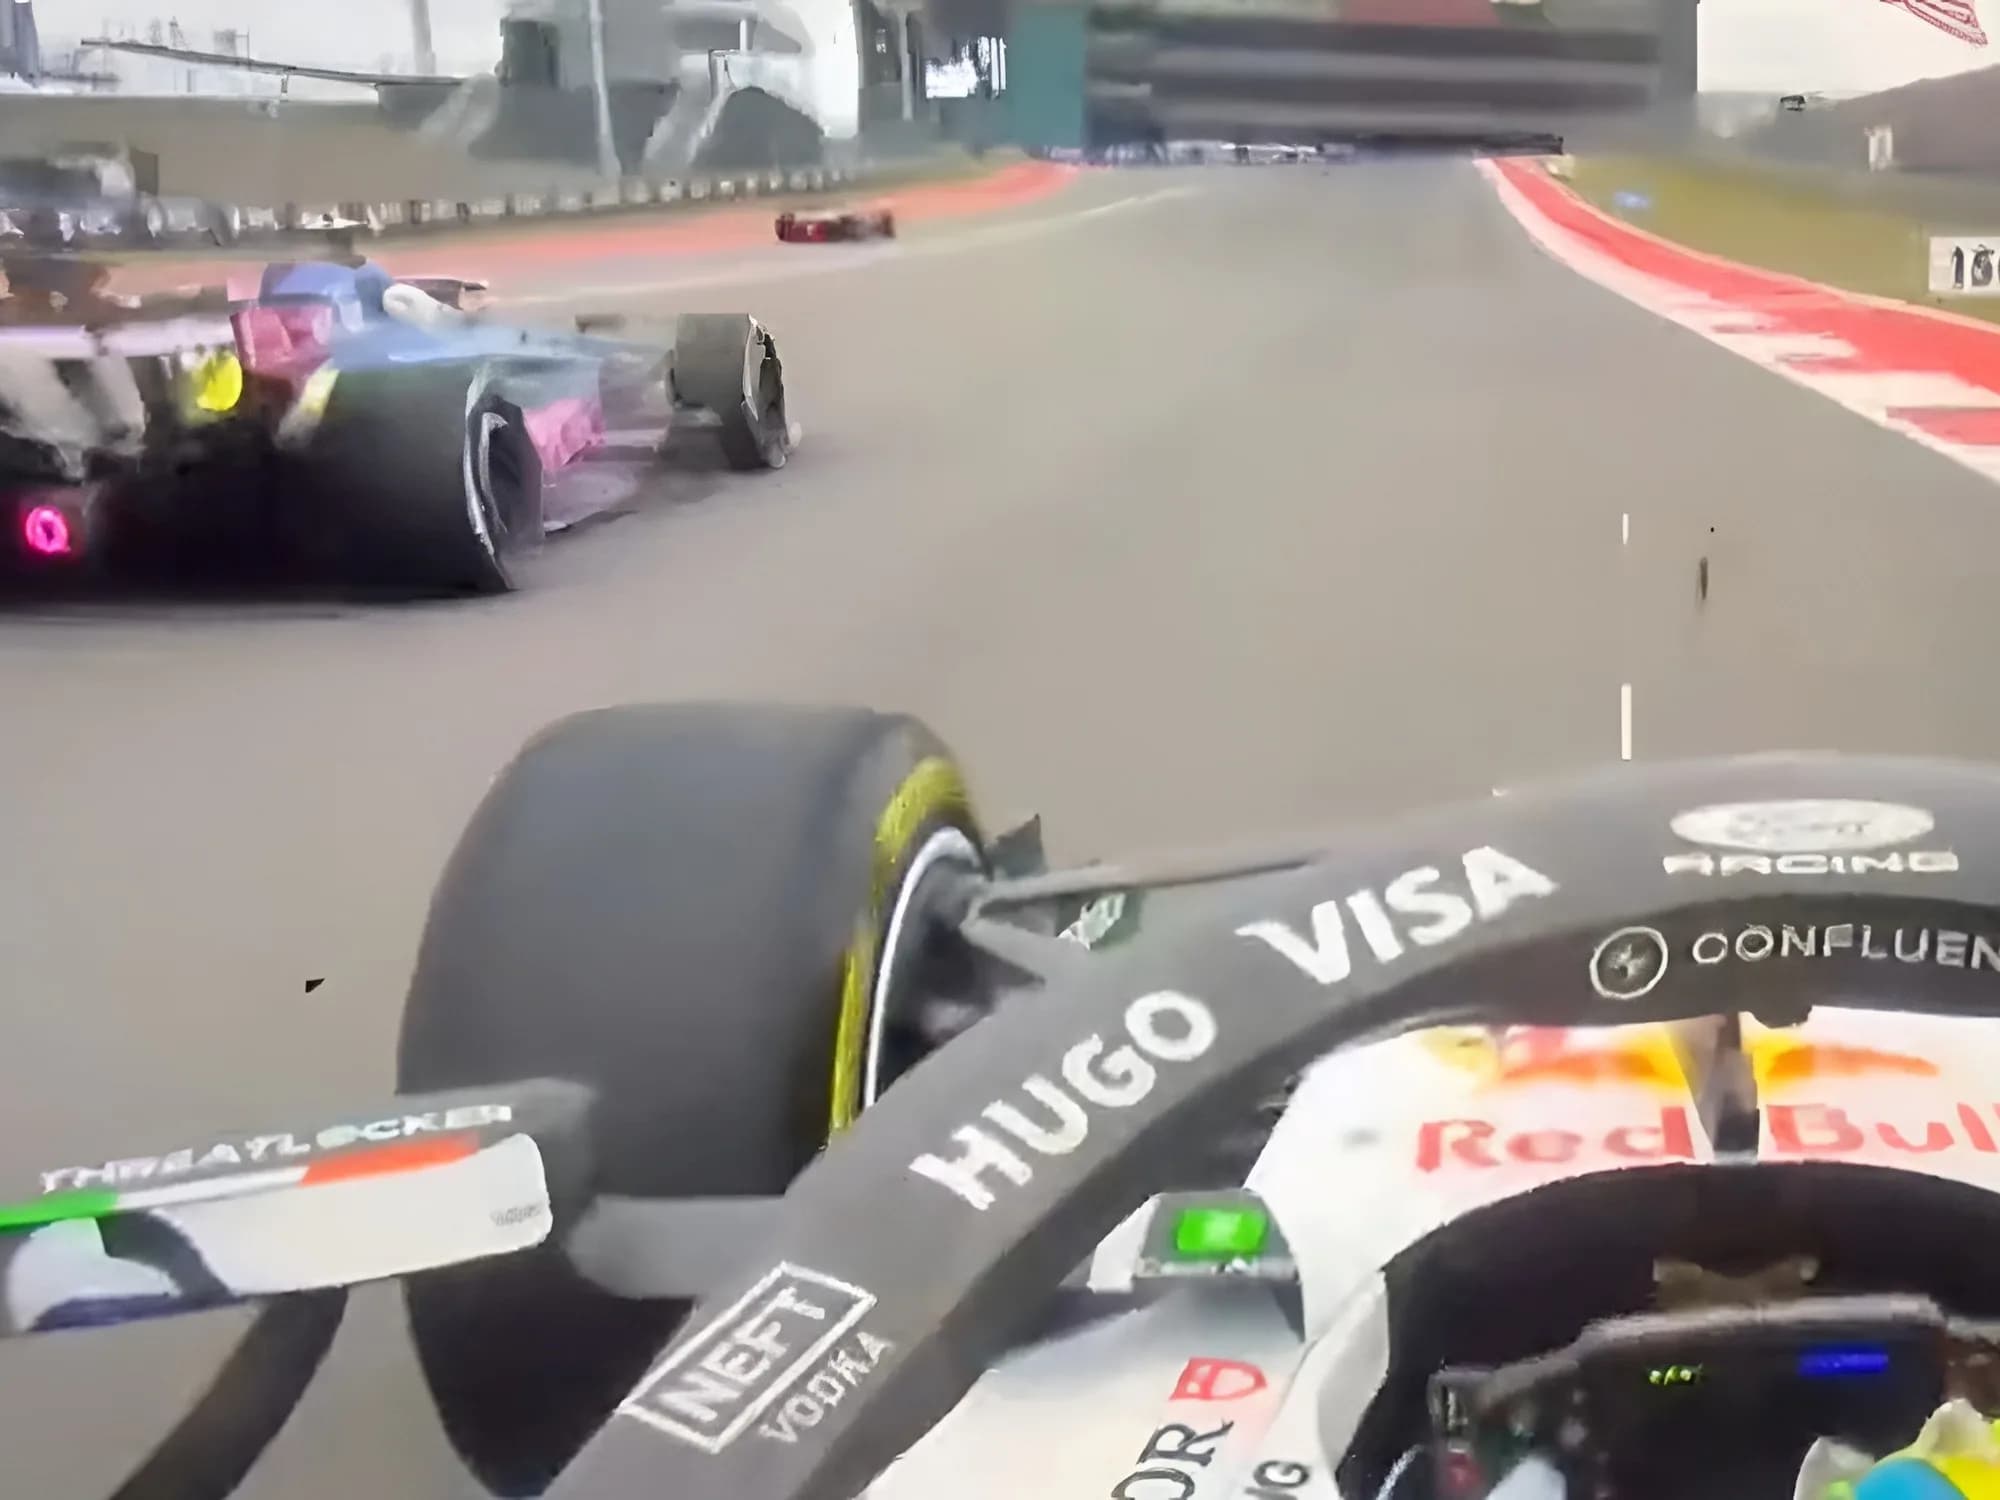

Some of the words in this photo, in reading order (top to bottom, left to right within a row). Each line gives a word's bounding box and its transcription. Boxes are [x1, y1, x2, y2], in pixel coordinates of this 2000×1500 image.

[1235, 846, 1560, 985] VISA
[908, 990, 1217, 1211] HUGO
[1415, 1106, 1696, 1173] Red
[1766, 1102, 2000, 1154] Bul
[658, 1286, 826, 1423] NEFT
[758, 1331, 894, 1443] VODKA
